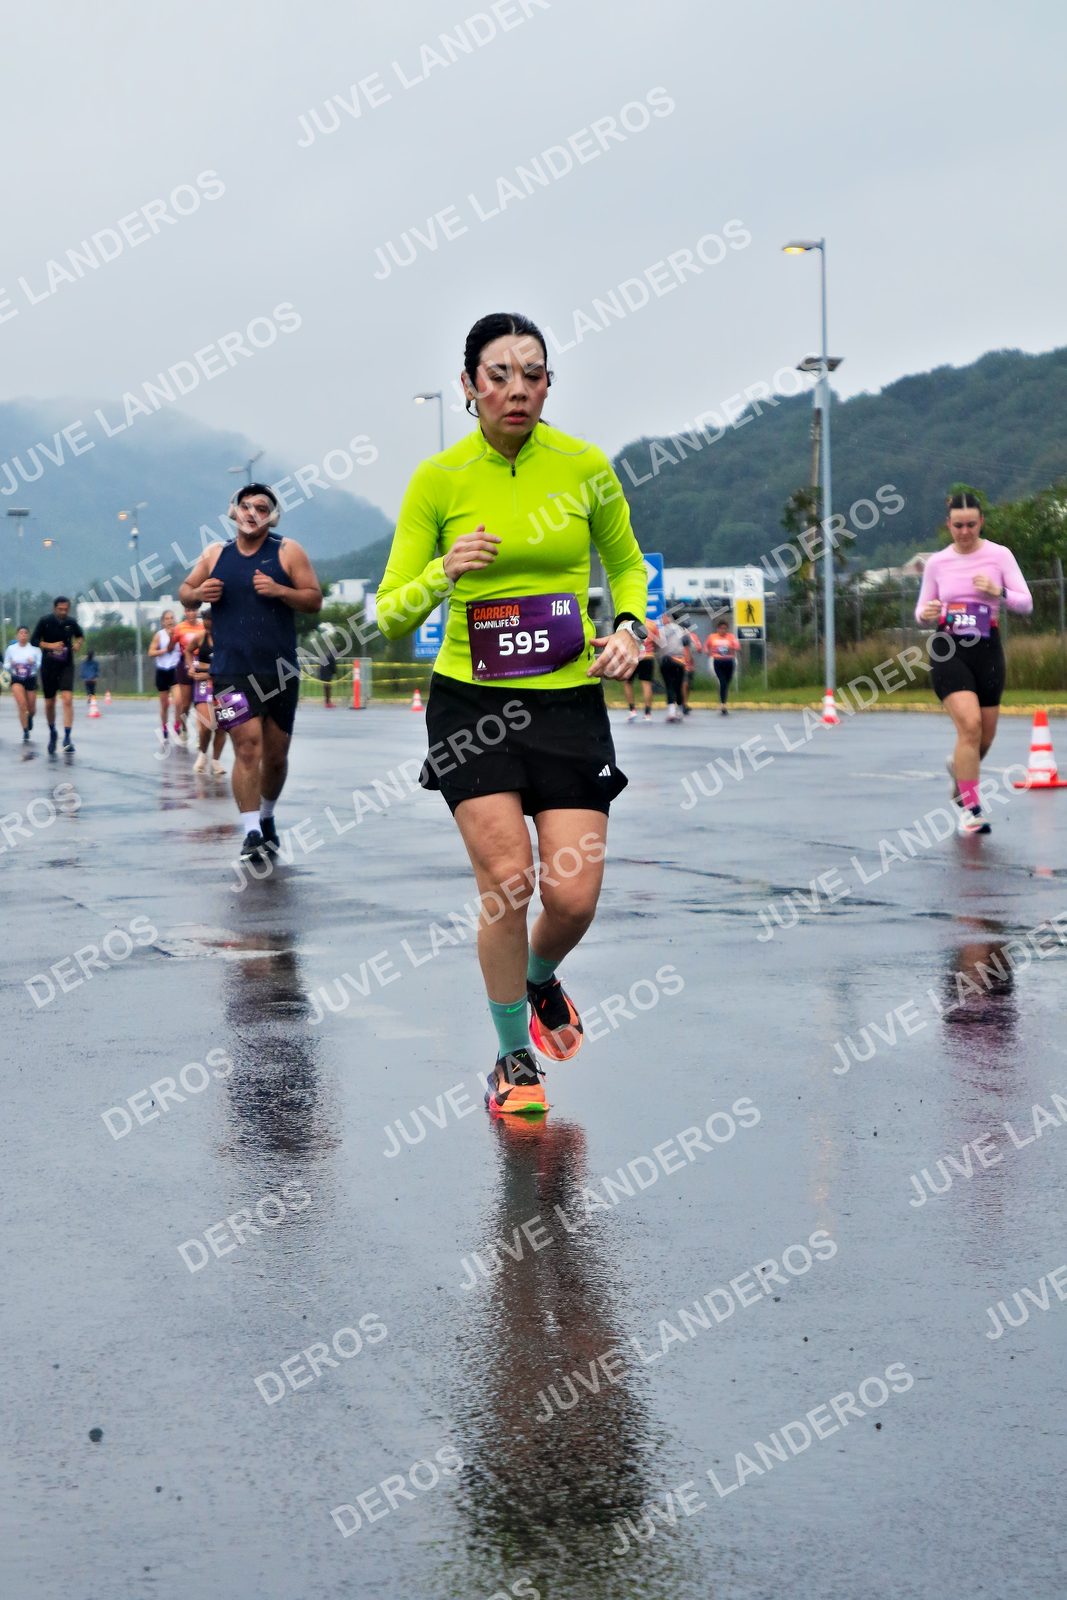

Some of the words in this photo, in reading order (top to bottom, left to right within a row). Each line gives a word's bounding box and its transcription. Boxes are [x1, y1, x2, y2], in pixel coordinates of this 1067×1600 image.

[473, 604, 520, 620] CARRERA
[551, 600, 571, 616] 15K
[498, 629, 550, 656] 595
